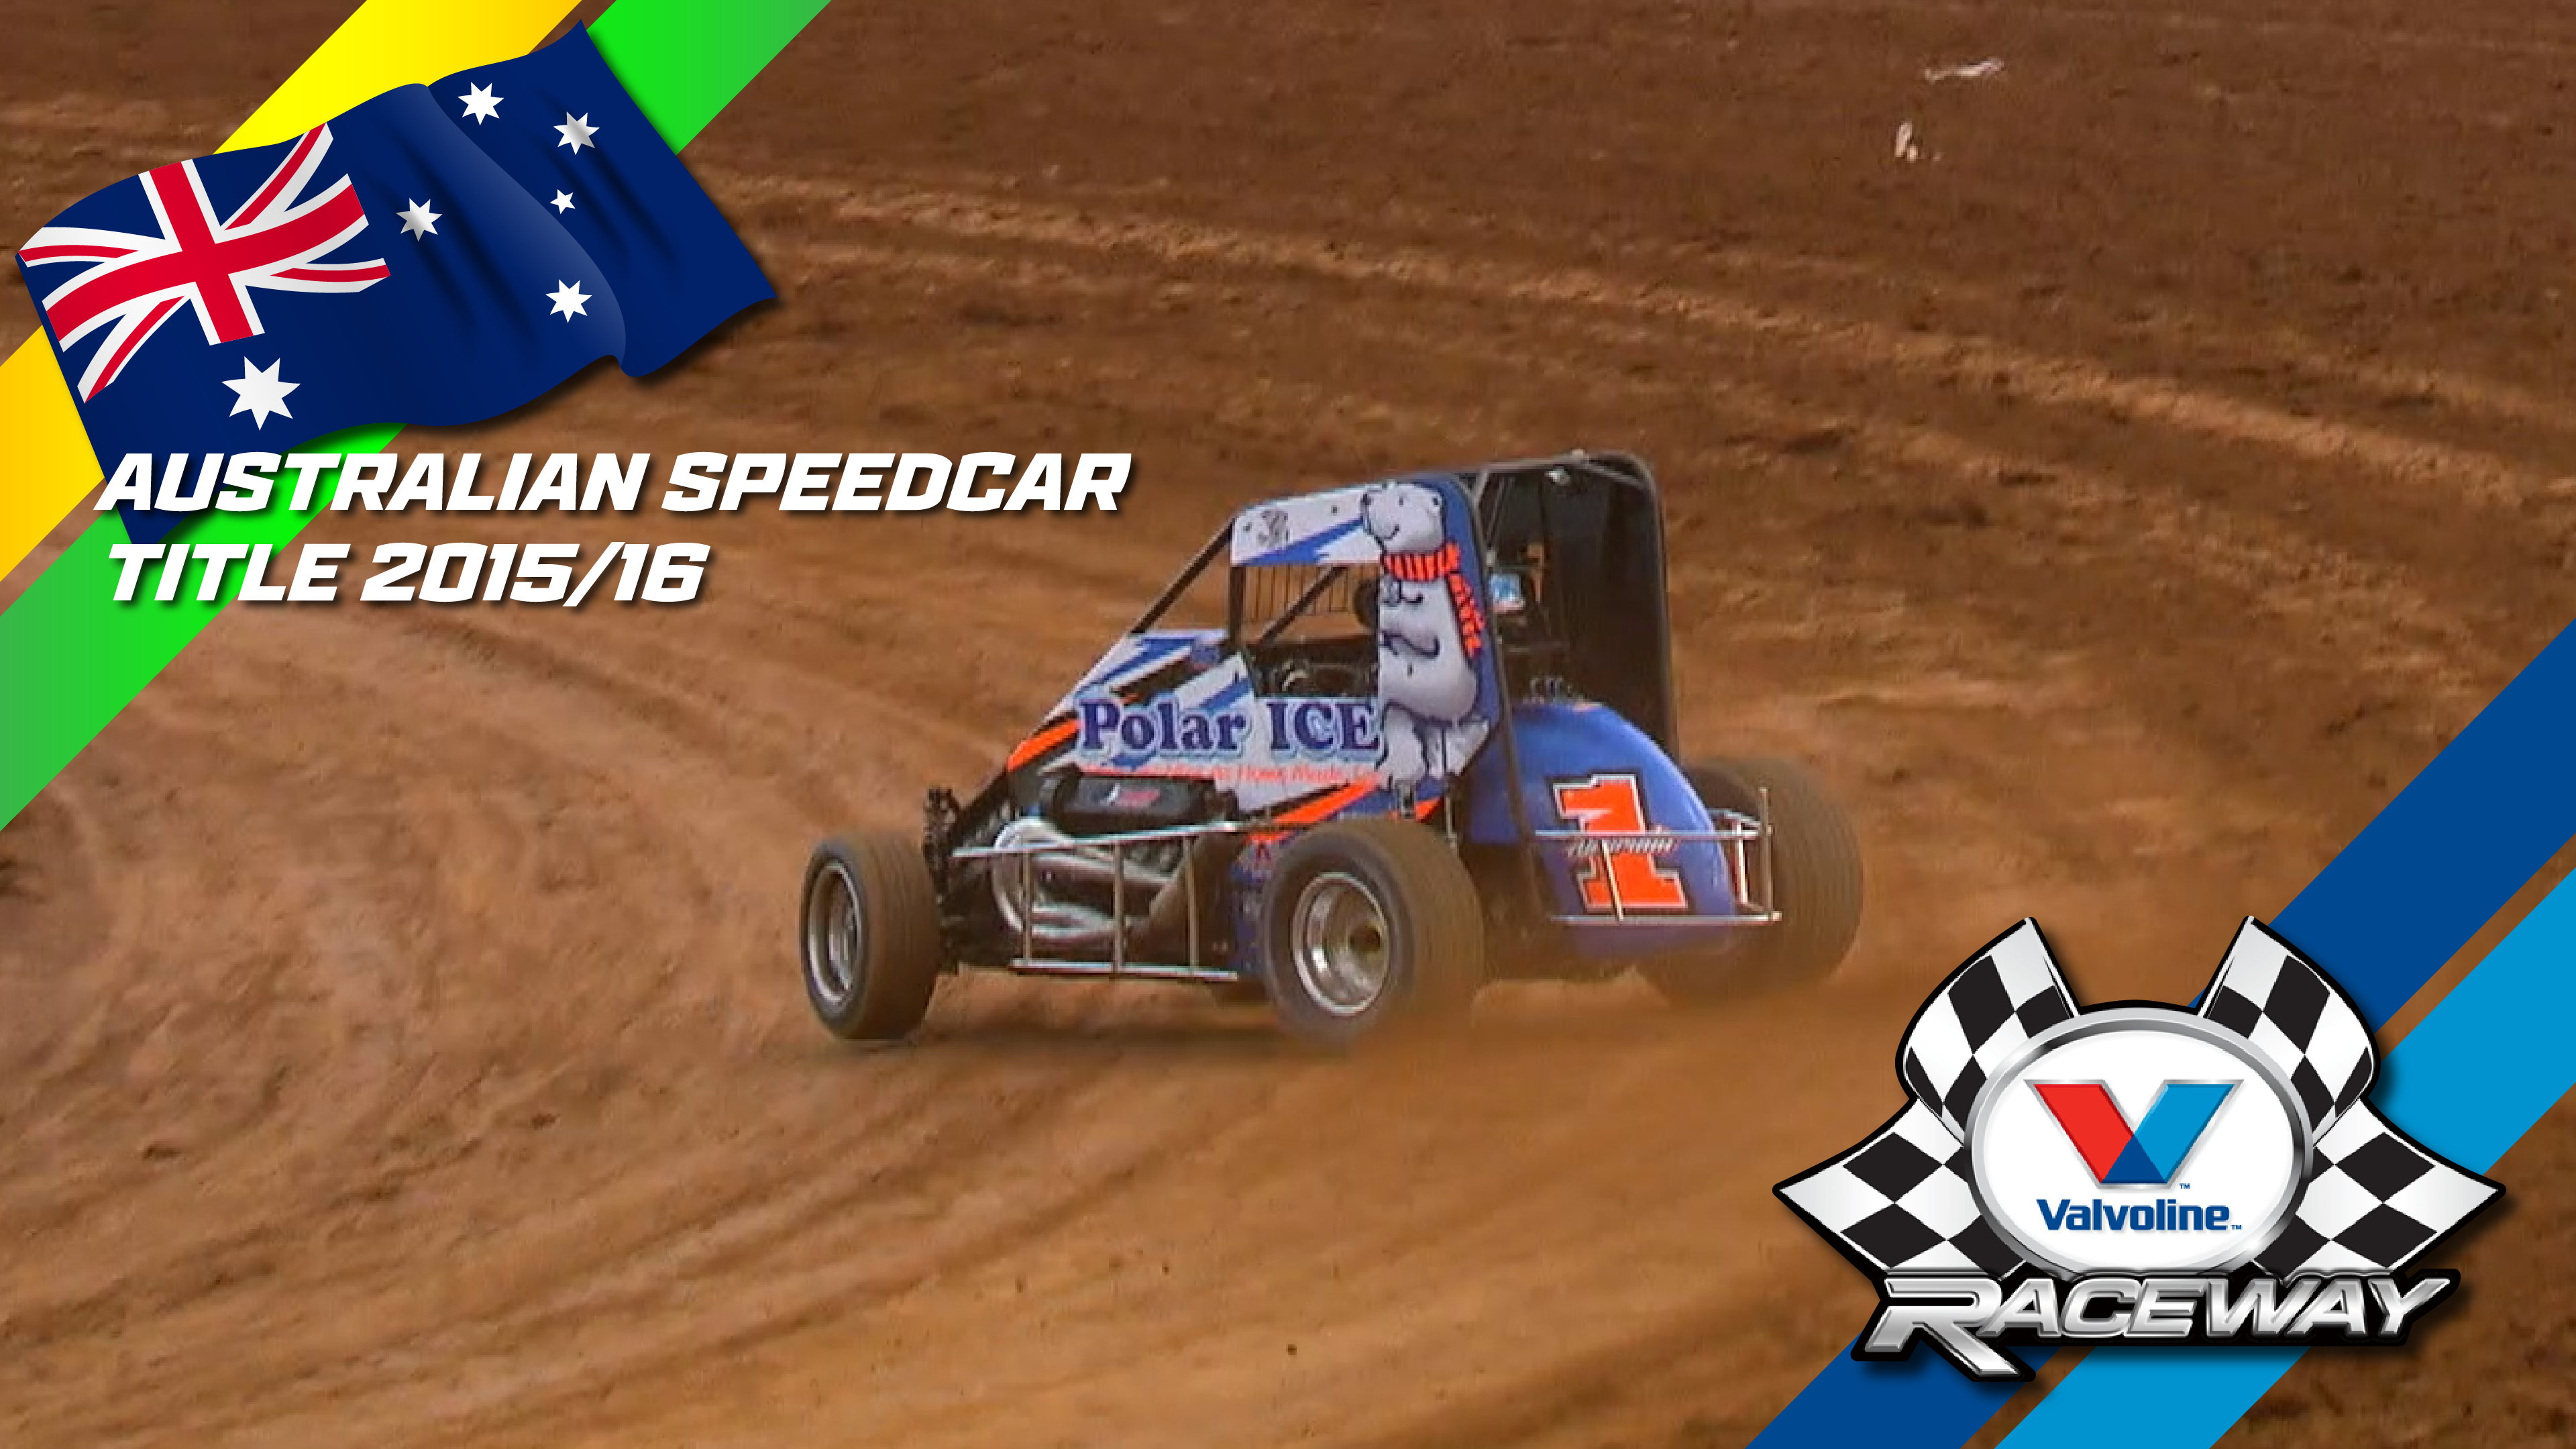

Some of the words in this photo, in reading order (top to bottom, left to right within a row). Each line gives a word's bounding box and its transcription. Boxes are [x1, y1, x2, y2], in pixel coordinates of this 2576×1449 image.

[1080, 699, 1248, 752] Polar
[1265, 700, 1381, 752] ICE
[1552, 773, 1688, 910] 1
